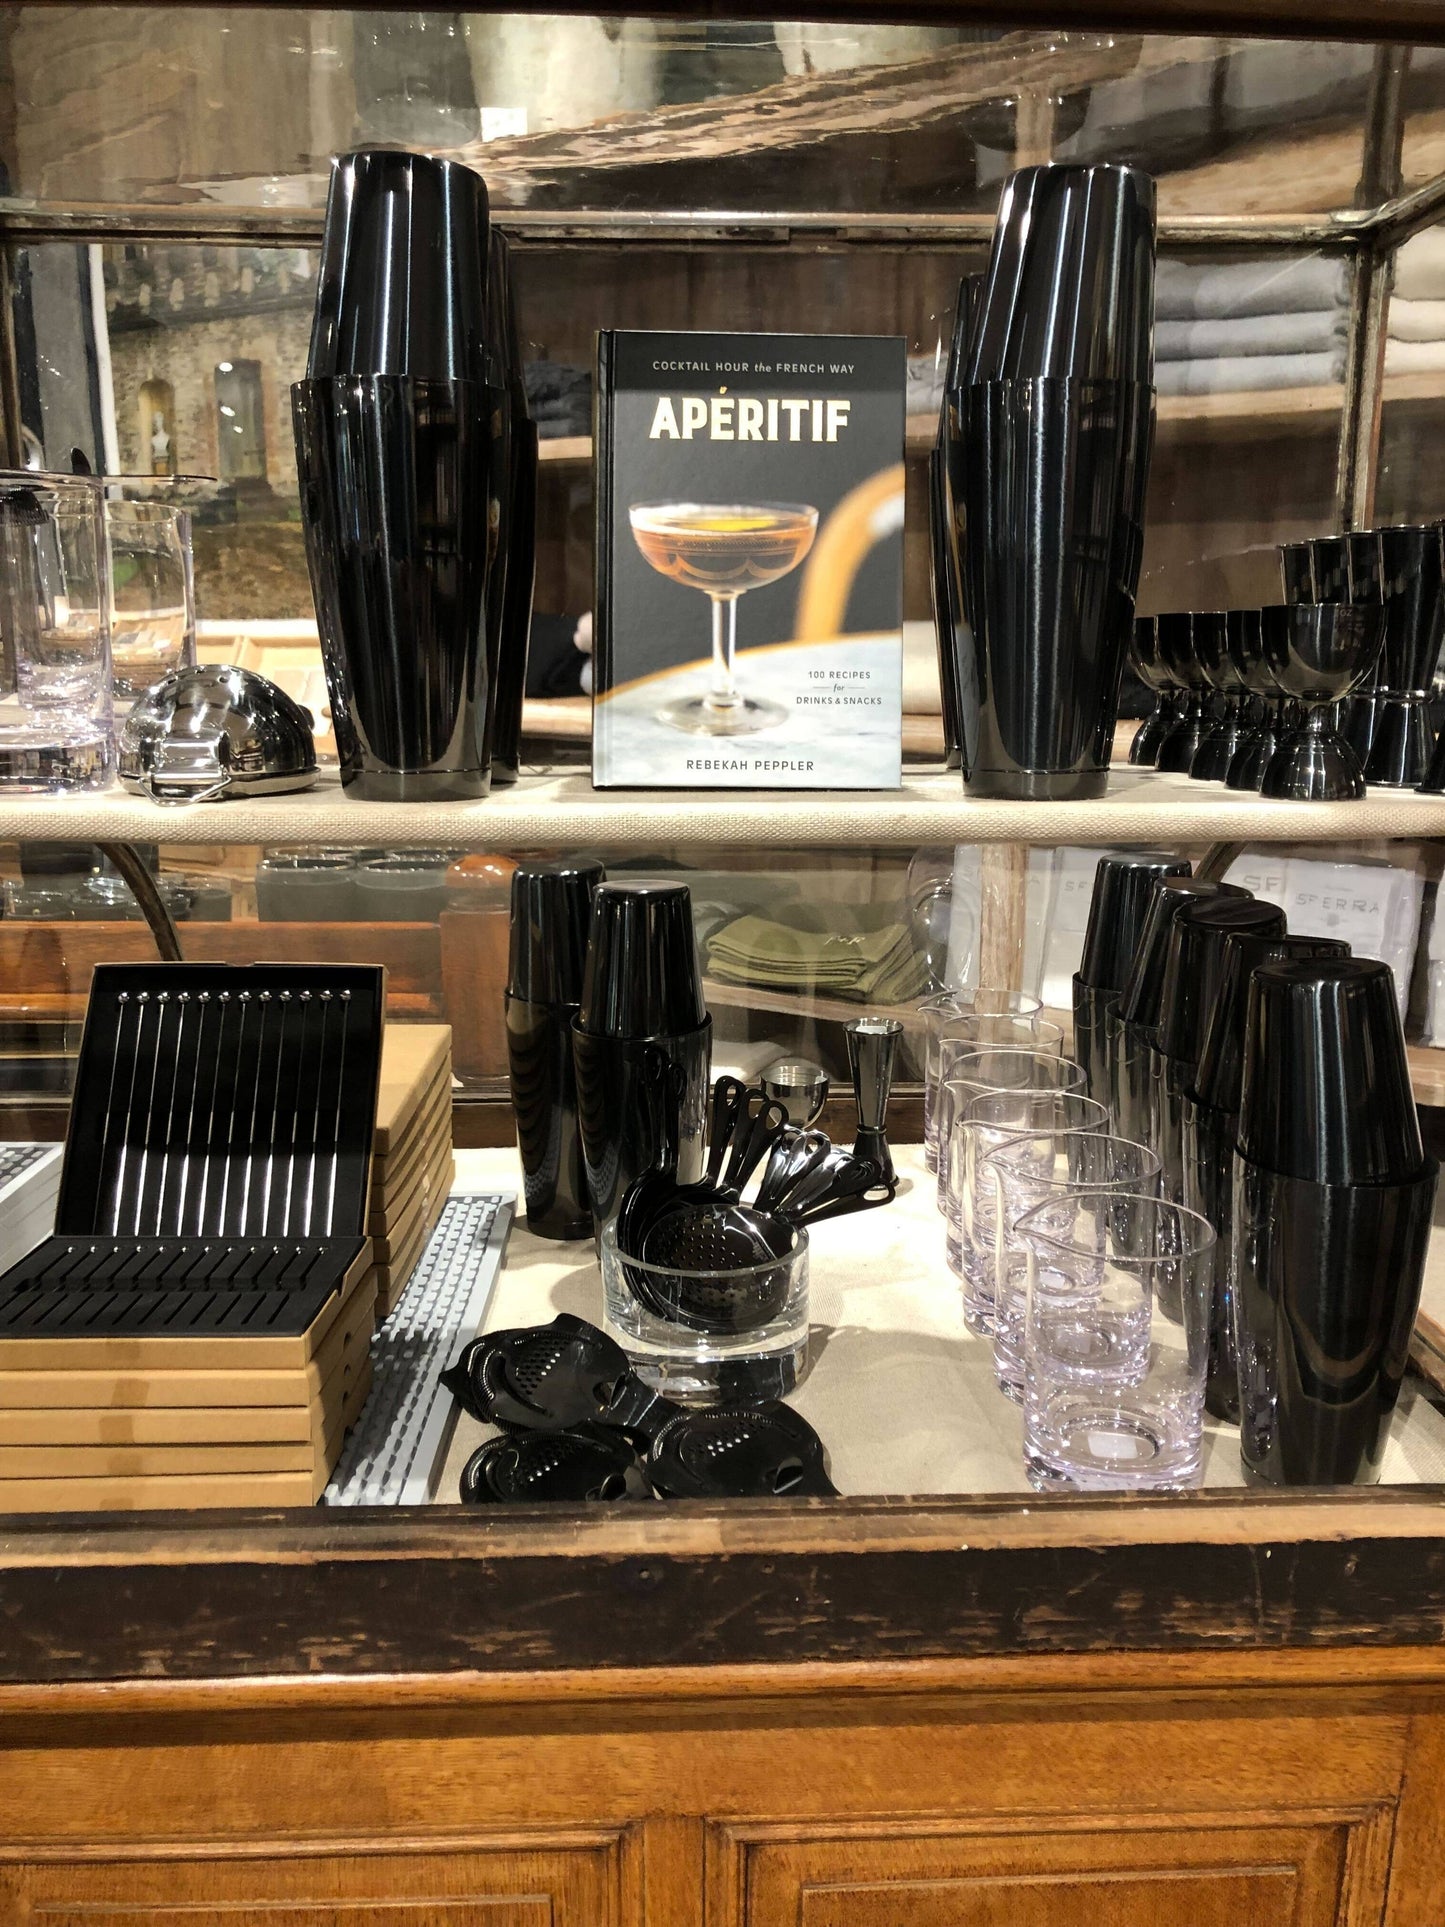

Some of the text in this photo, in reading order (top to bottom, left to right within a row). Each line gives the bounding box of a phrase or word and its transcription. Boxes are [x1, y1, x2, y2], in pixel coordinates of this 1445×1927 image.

[652, 360, 855, 375] COCKTAIL HOUR the FRENCH WAY
[648, 386, 851, 442] APÉRITIF
[807, 670, 872, 680] 100 RECIPES
[832, 683, 846, 693] for
[796, 696, 883, 706] DRINKS & SNACKS
[686, 759, 815, 772] REBEKAH PEPPLER
[1295, 892, 1380, 914] SFERRA
